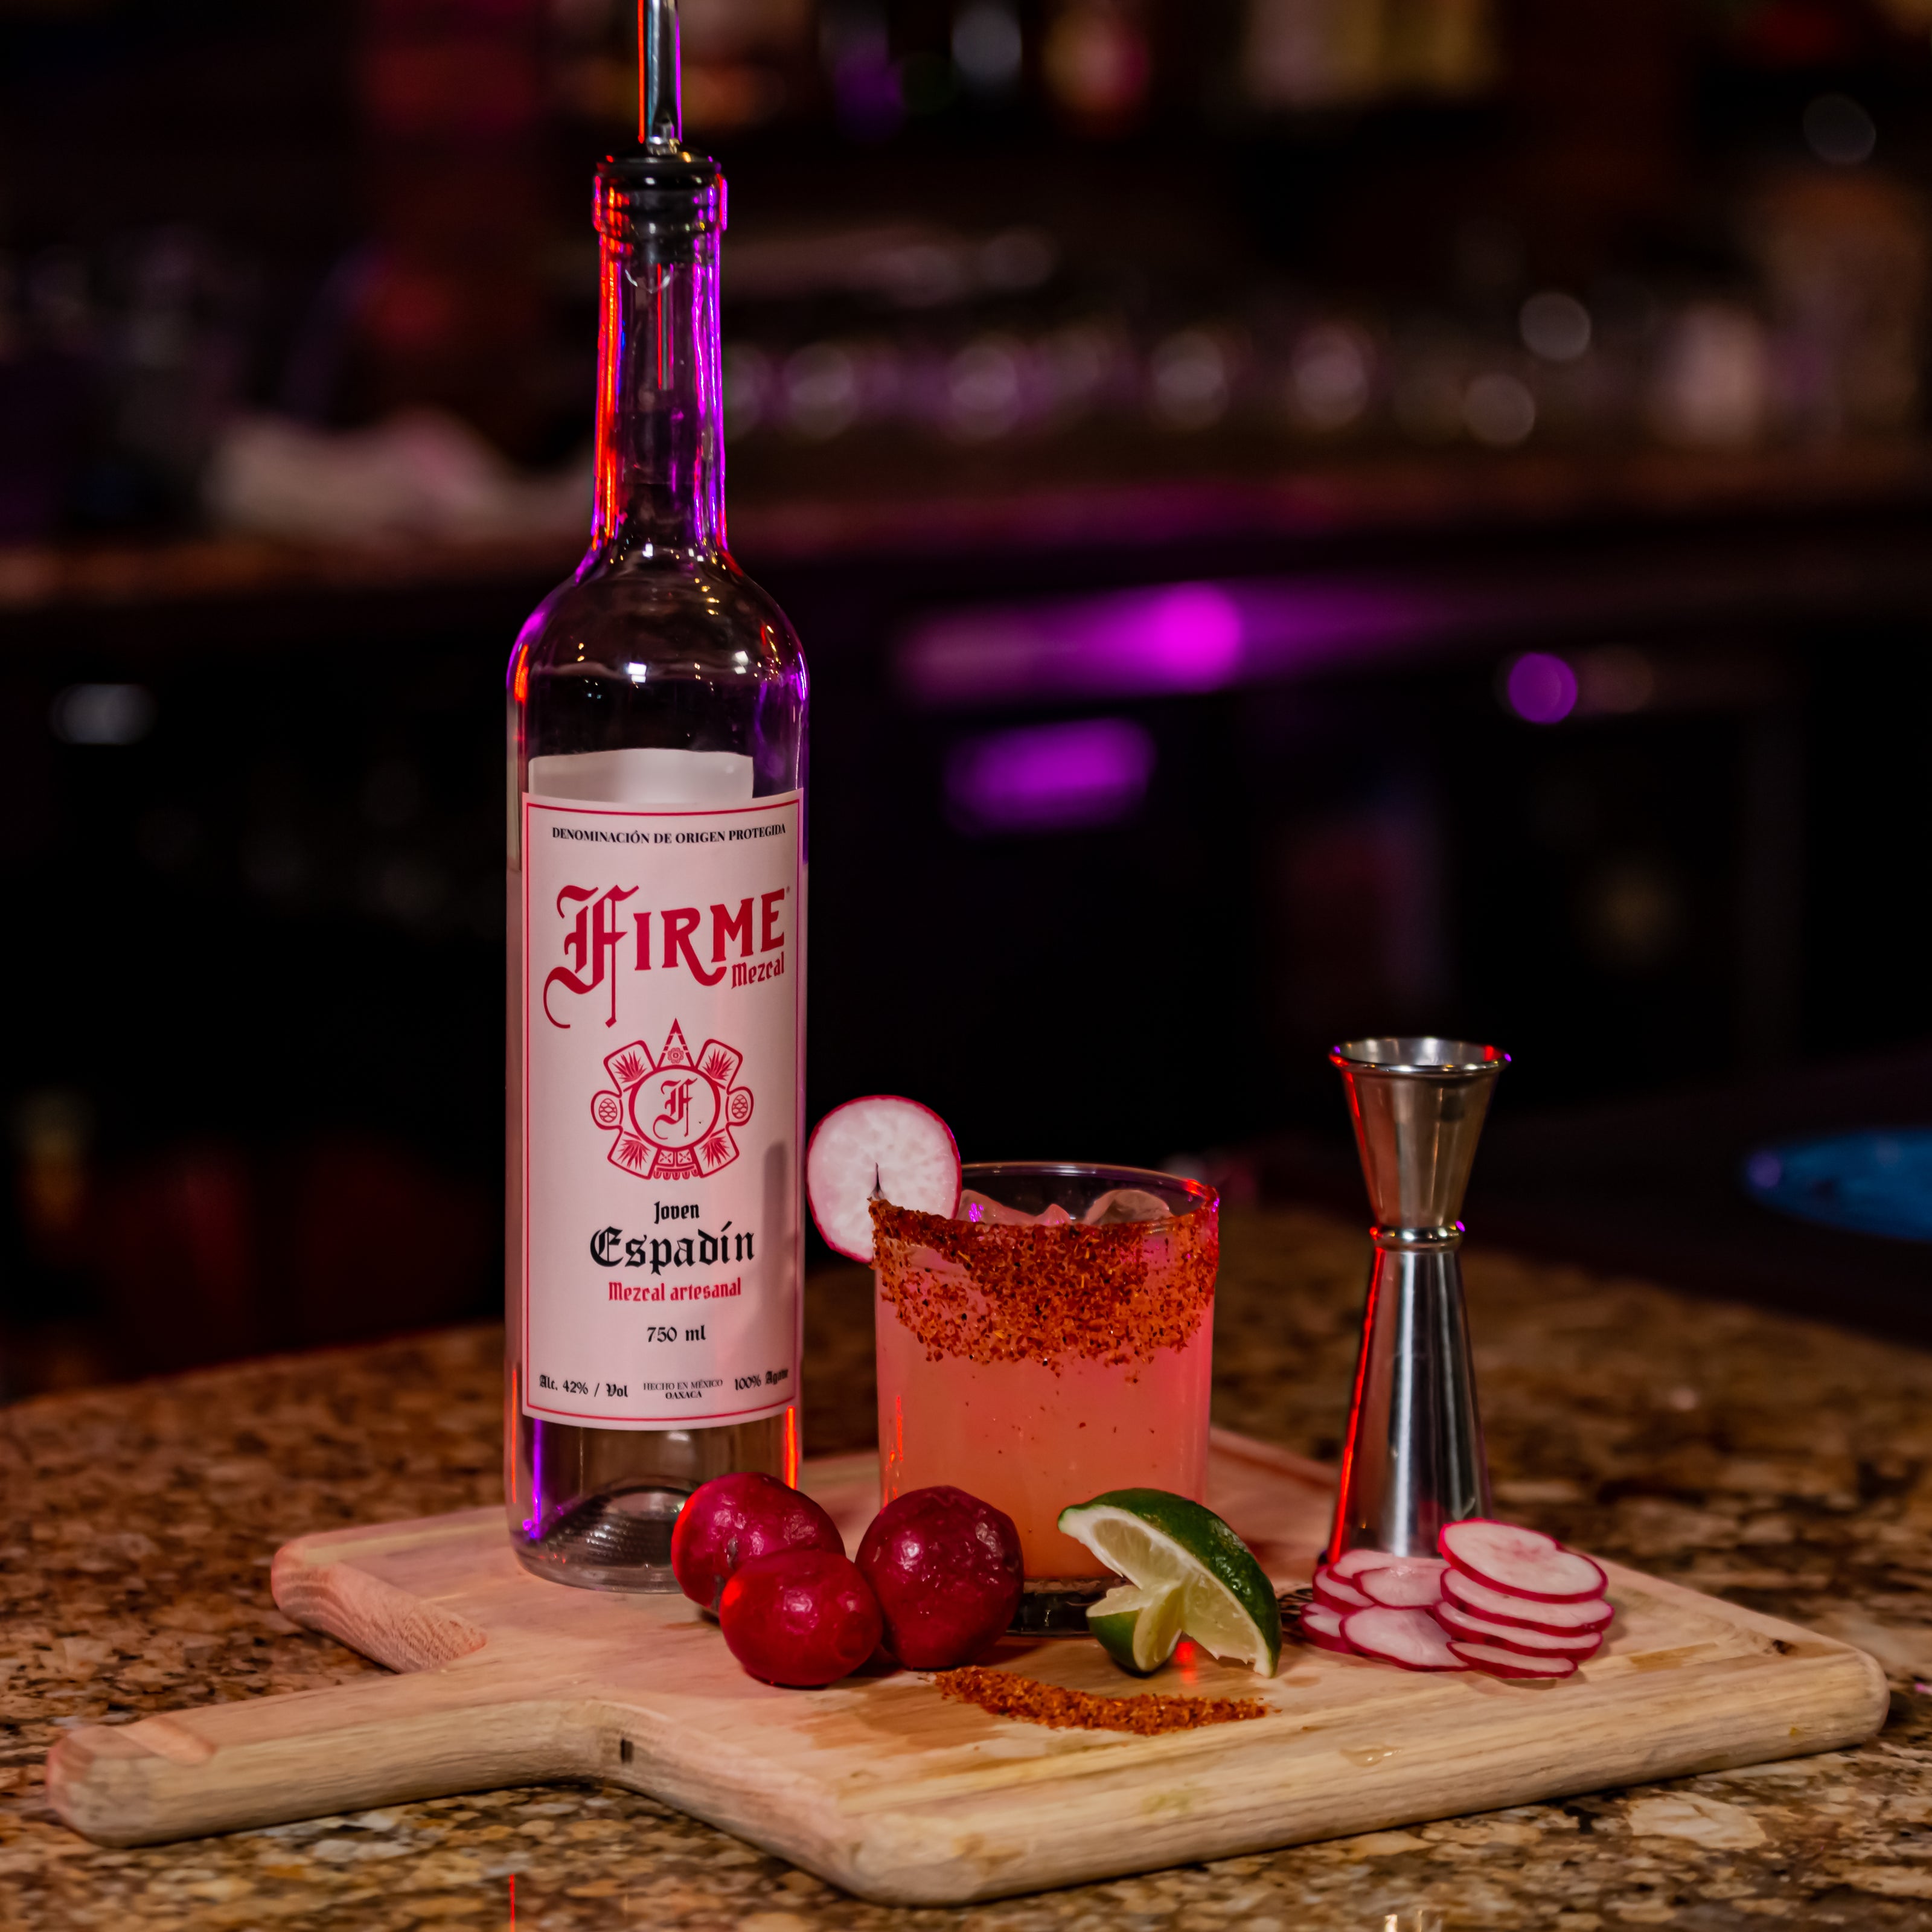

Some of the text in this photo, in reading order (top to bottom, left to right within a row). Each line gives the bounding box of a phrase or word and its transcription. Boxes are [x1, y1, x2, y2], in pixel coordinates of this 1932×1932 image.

[552, 823, 787, 845] DENOMINACIÓN DE ORIGEN PROTEGIDA
[731, 952, 785, 990] Mezcal
[653, 1201, 700, 1224] Joven
[589, 1221, 755, 1276] Espadín
[609, 1277, 741, 1302] Mezcal artesanal
[647, 1325, 706, 1343] 750 ml
[539, 1374, 629, 1398] Alc. 42% / Vol
[643, 1378, 723, 1391] HECHO EN MÉXICO
[735, 1375, 761, 1391] 100%
[665, 1390, 702, 1399] OAXACA
